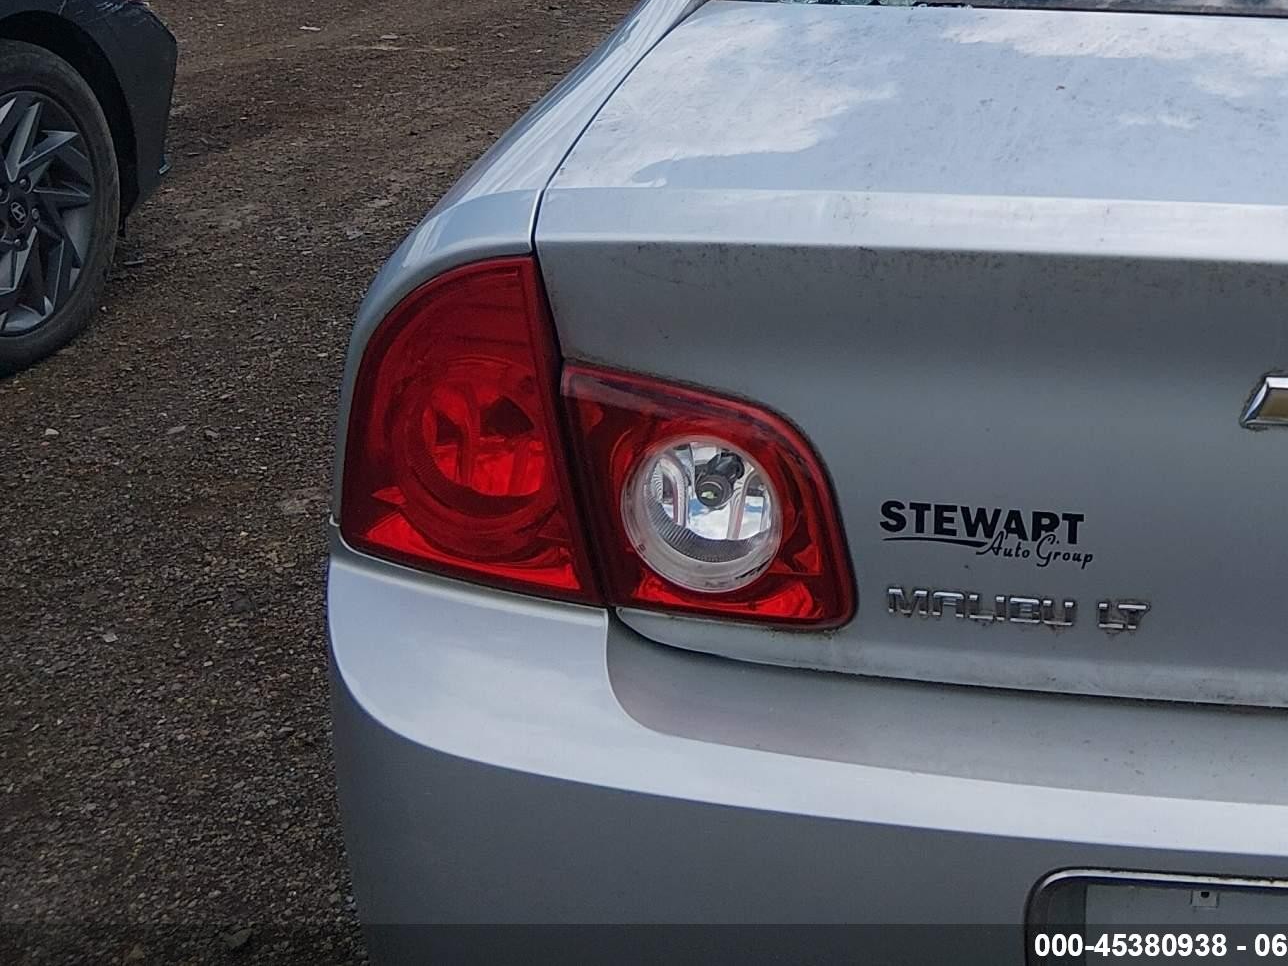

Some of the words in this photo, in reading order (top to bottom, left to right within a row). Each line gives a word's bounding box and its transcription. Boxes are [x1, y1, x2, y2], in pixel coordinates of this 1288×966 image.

[879, 500, 1085, 545] STEWART
[975, 531, 1031, 556] Auto
[1036, 534, 1094, 570] Group
[887, 587, 1075, 626] MALIBU
[1097, 601, 1149, 630] LT
